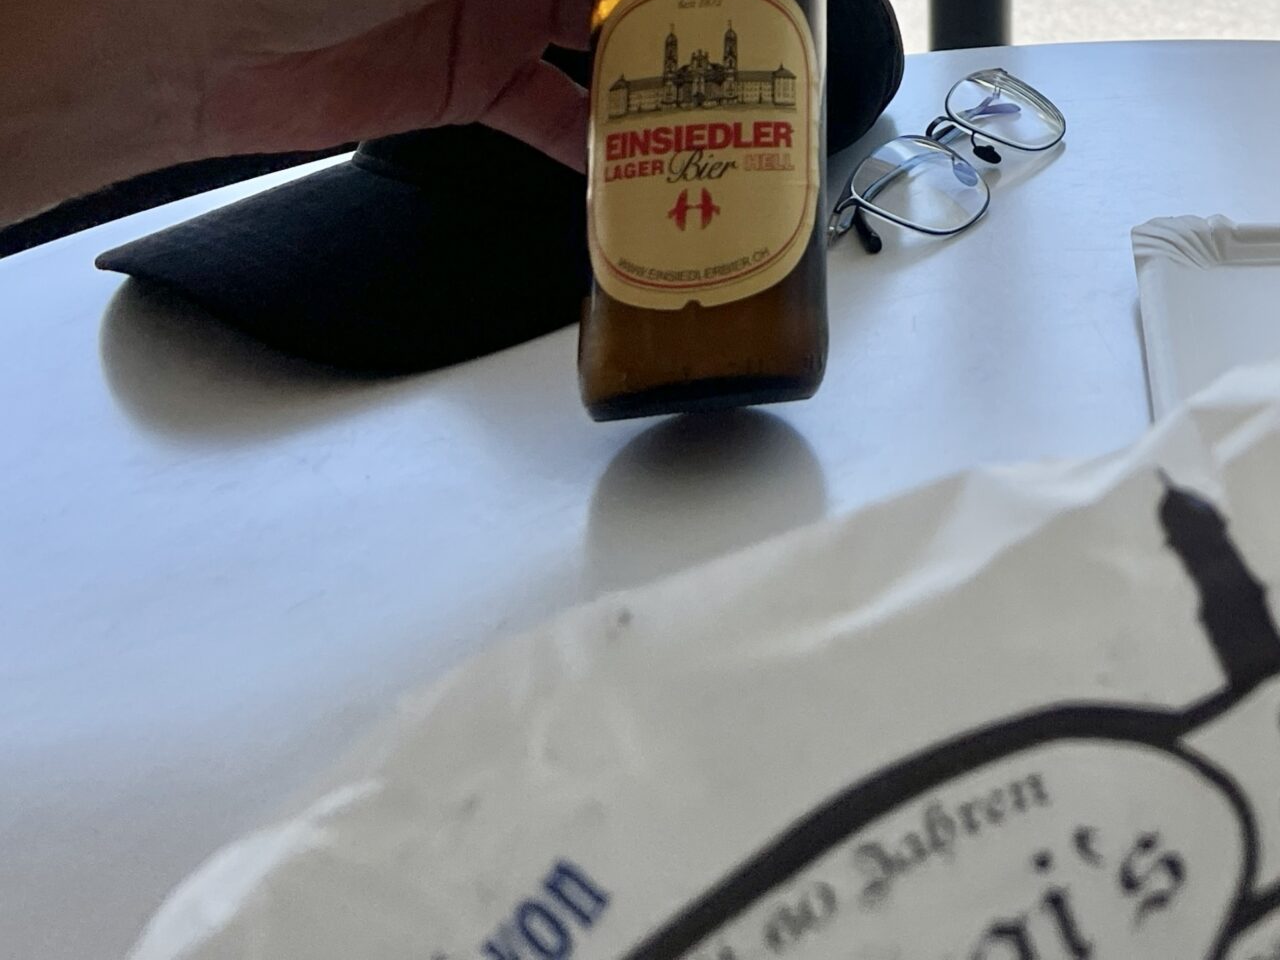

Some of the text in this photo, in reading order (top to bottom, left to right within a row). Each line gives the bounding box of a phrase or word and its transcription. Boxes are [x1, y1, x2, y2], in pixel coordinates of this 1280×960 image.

[605, 121, 794, 161] EINSIEDLER
[604, 146, 795, 183] LAGER Bier HELL
[851, 770, 1050, 909] Jahren
